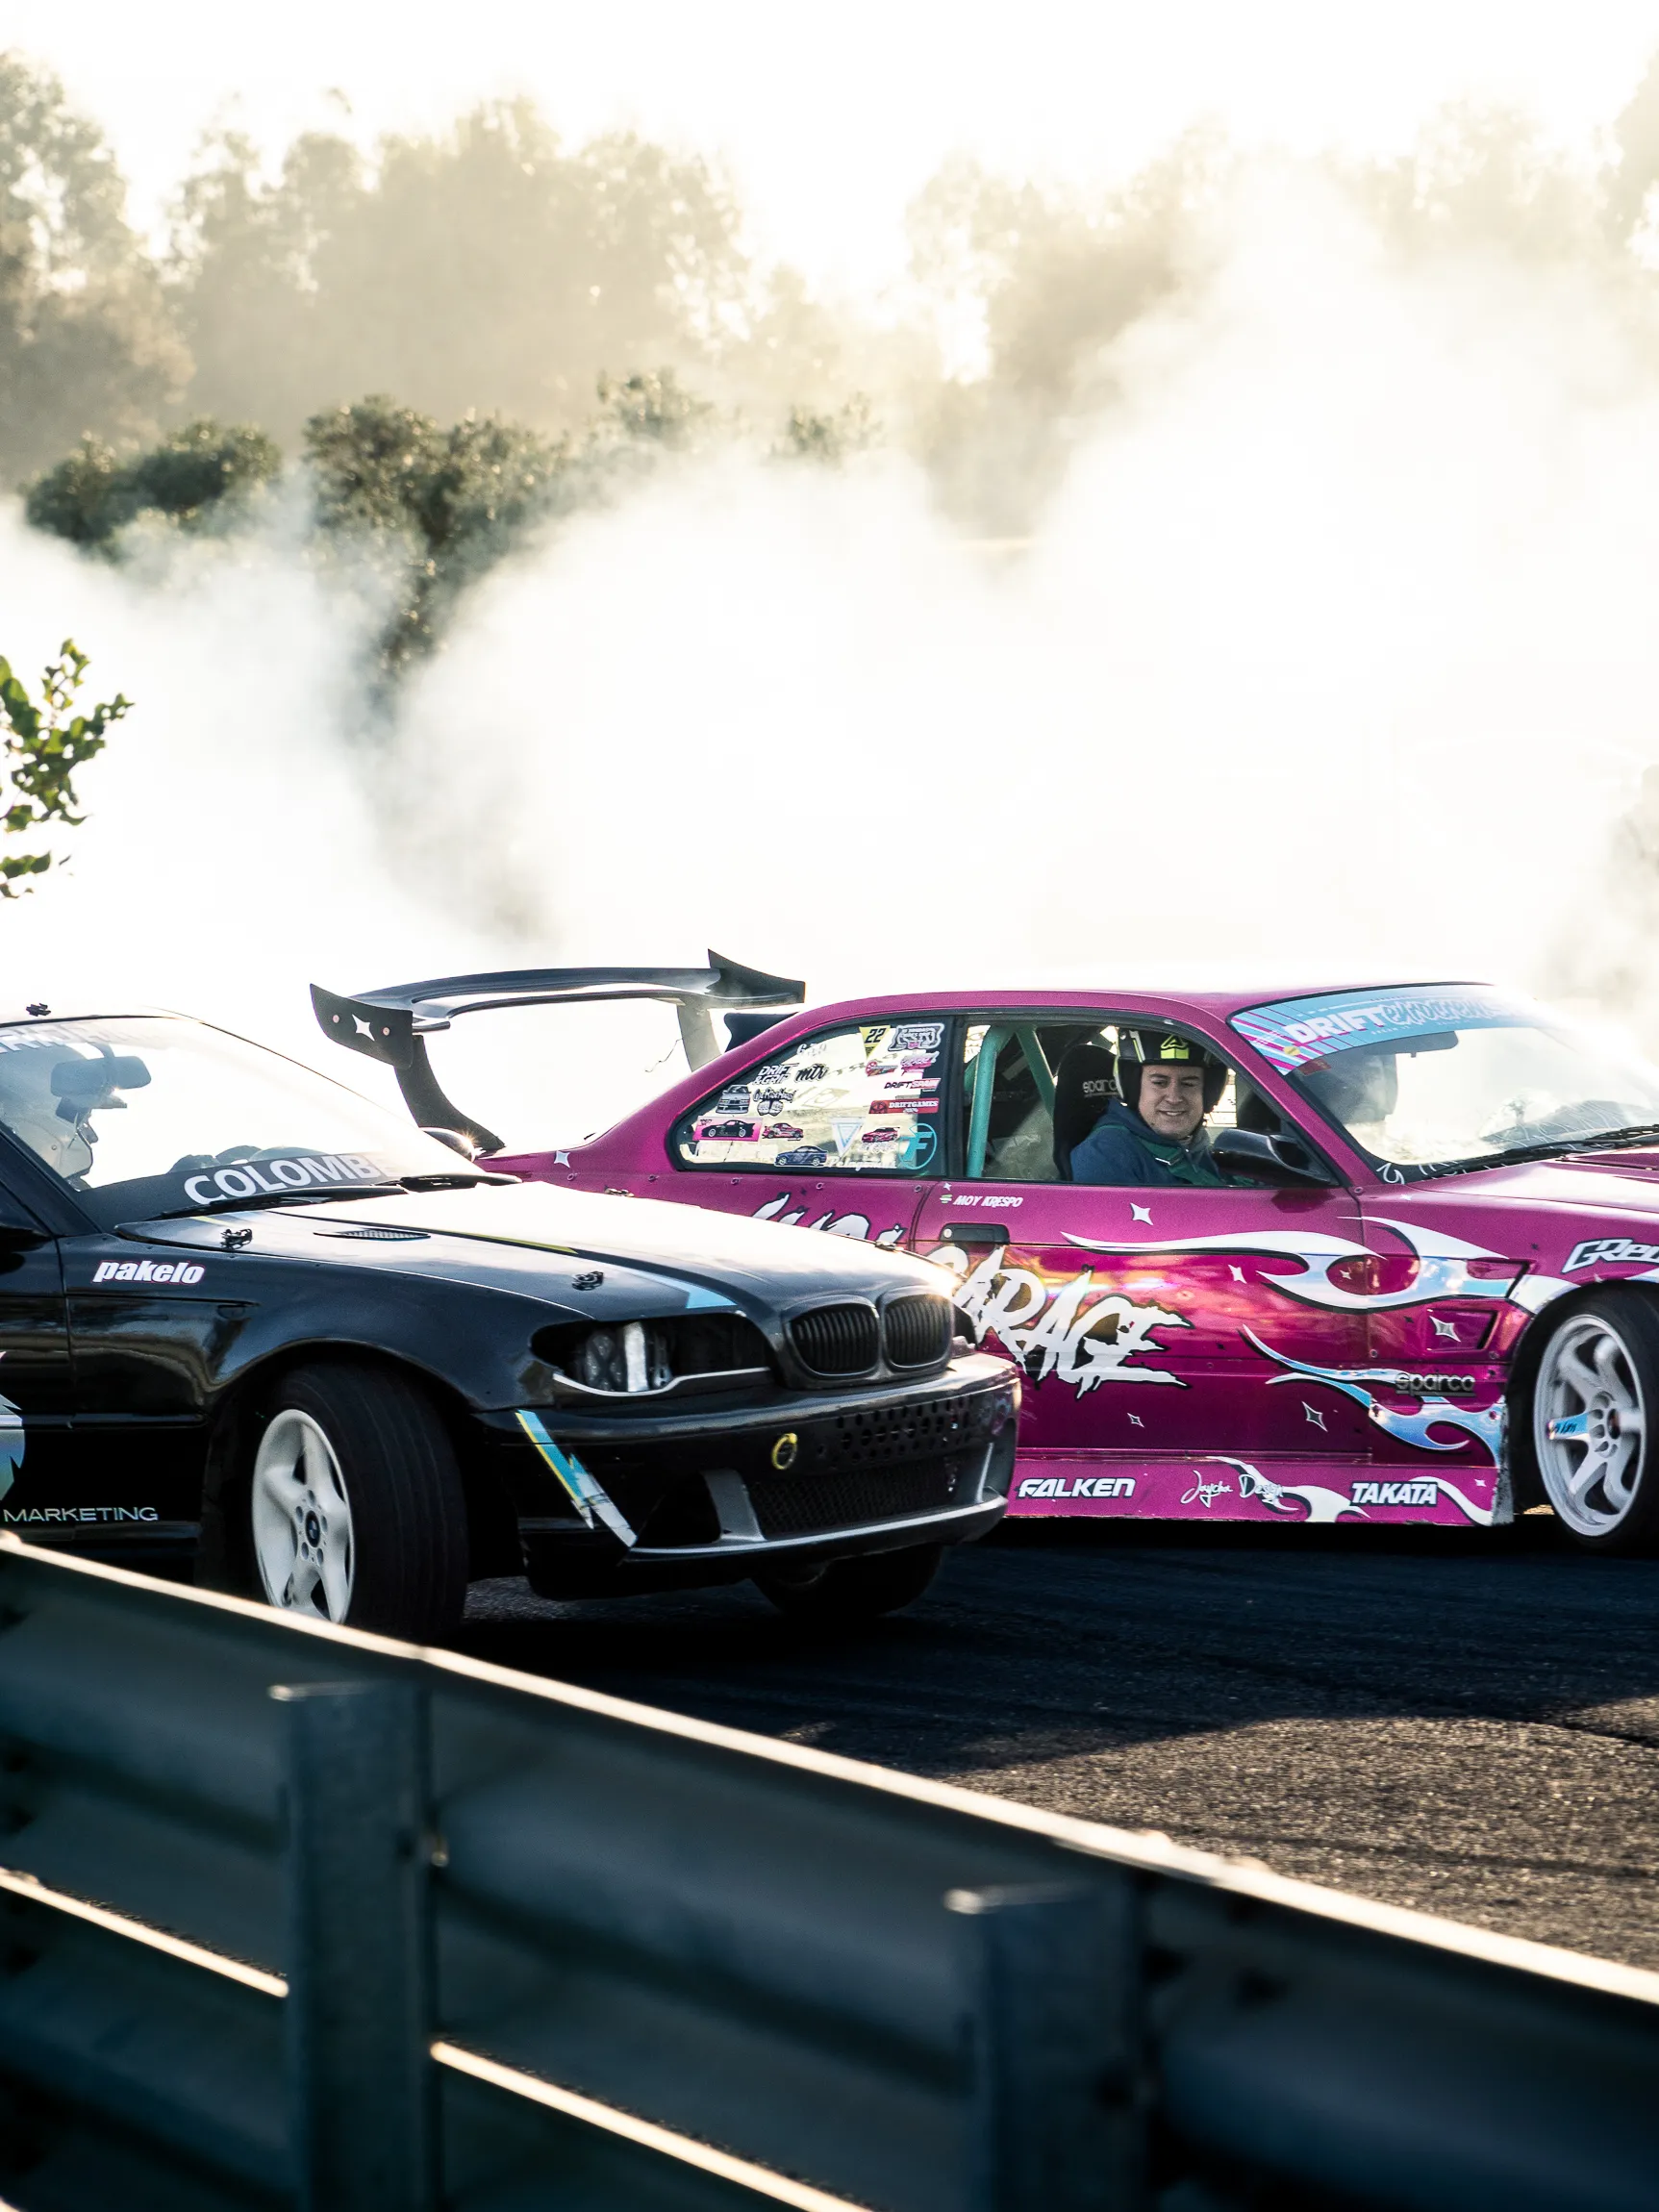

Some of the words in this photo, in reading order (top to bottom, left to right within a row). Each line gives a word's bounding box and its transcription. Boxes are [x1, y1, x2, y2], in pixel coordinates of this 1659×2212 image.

[866, 1027, 886, 1043] 22
[1083, 1079, 1117, 1093] sparc
[184, 1154, 396, 1205] COLOMB
[953, 1195, 983, 1206] MOY
[981, 1196, 1023, 1208] KRESPO
[92, 1260, 205, 1284] pakelo
[1395, 1373, 1475, 1395] sparco
[1018, 1478, 1136, 1497] FALKEN
[1351, 1482, 1438, 1505] TAKATA
[3, 1507, 159, 1522] MARKETING
